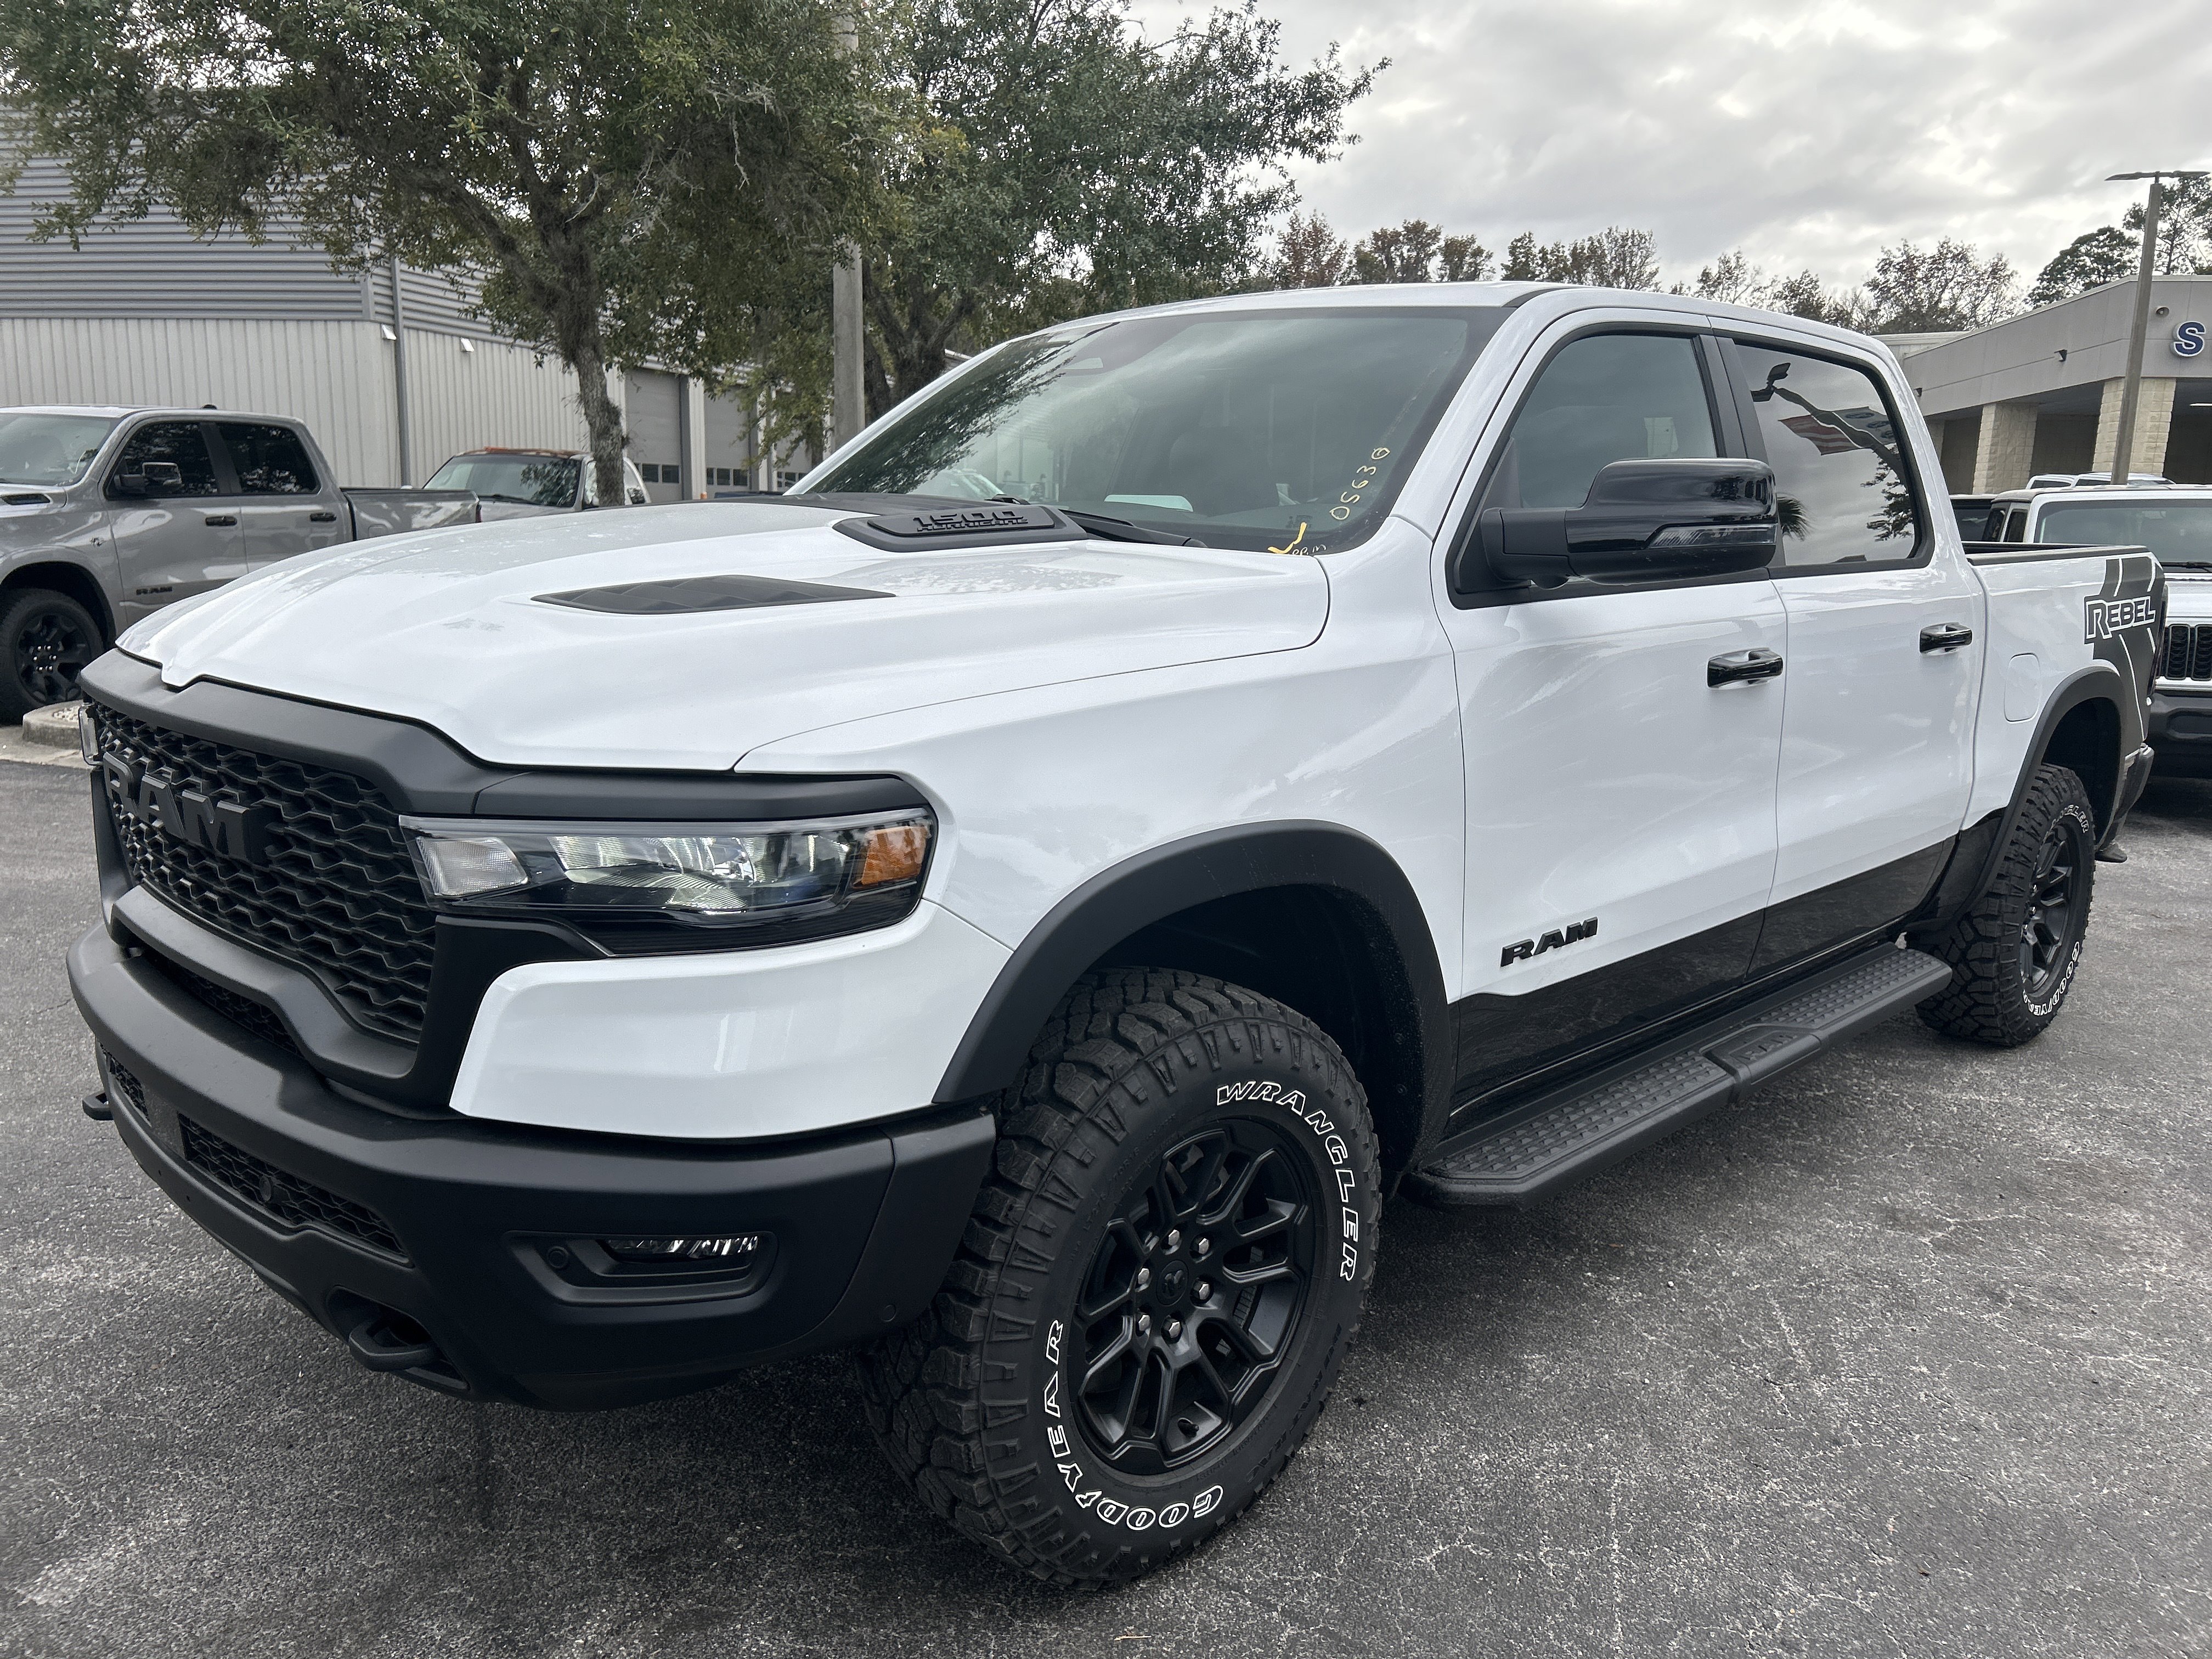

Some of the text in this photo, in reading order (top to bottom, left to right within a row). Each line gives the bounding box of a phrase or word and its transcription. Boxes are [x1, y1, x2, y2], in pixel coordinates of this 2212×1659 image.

[2172, 320, 2207, 357] S
[913, 511, 1024, 526] 1500
[917, 518, 1029, 532] HURRICANE
[2085, 595, 2156, 640] REBEL
[103, 751, 261, 860] RAM
[1500, 916, 1598, 968] RAM
[1216, 1080, 1359, 1282] WRANGLER
[1043, 1319, 1224, 1531] GOODYEAR
